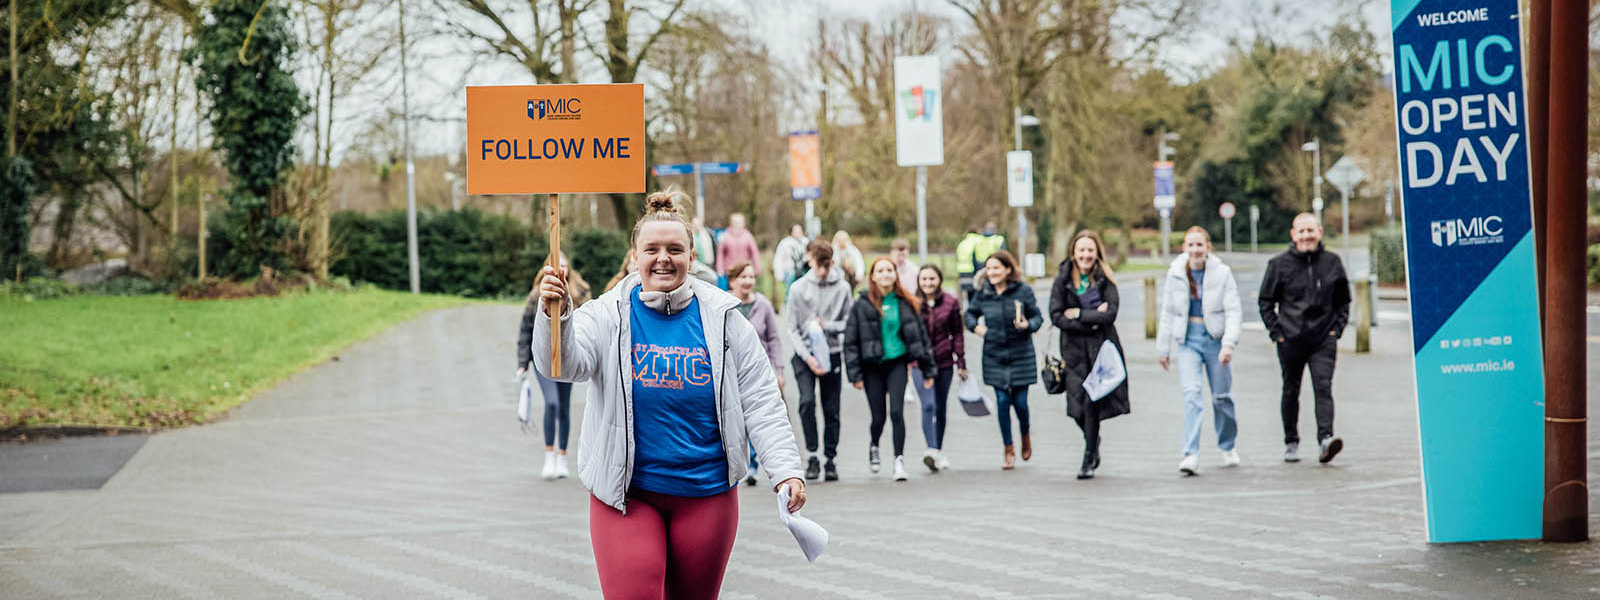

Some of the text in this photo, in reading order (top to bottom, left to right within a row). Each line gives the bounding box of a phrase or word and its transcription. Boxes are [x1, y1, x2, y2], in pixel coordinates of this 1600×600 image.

[1417, 8, 1489, 27] WELCOME
[1400, 35, 1514, 93] MIC
[547, 98, 581, 113] MIC
[1401, 91, 1518, 136] OPEN
[481, 137, 630, 160] FOLLOW ME
[1406, 133, 1519, 188] DAY
[1456, 215, 1504, 238] MIC
[632, 348, 711, 385] MIC
[1440, 359, 1515, 375] www.mic.ie
